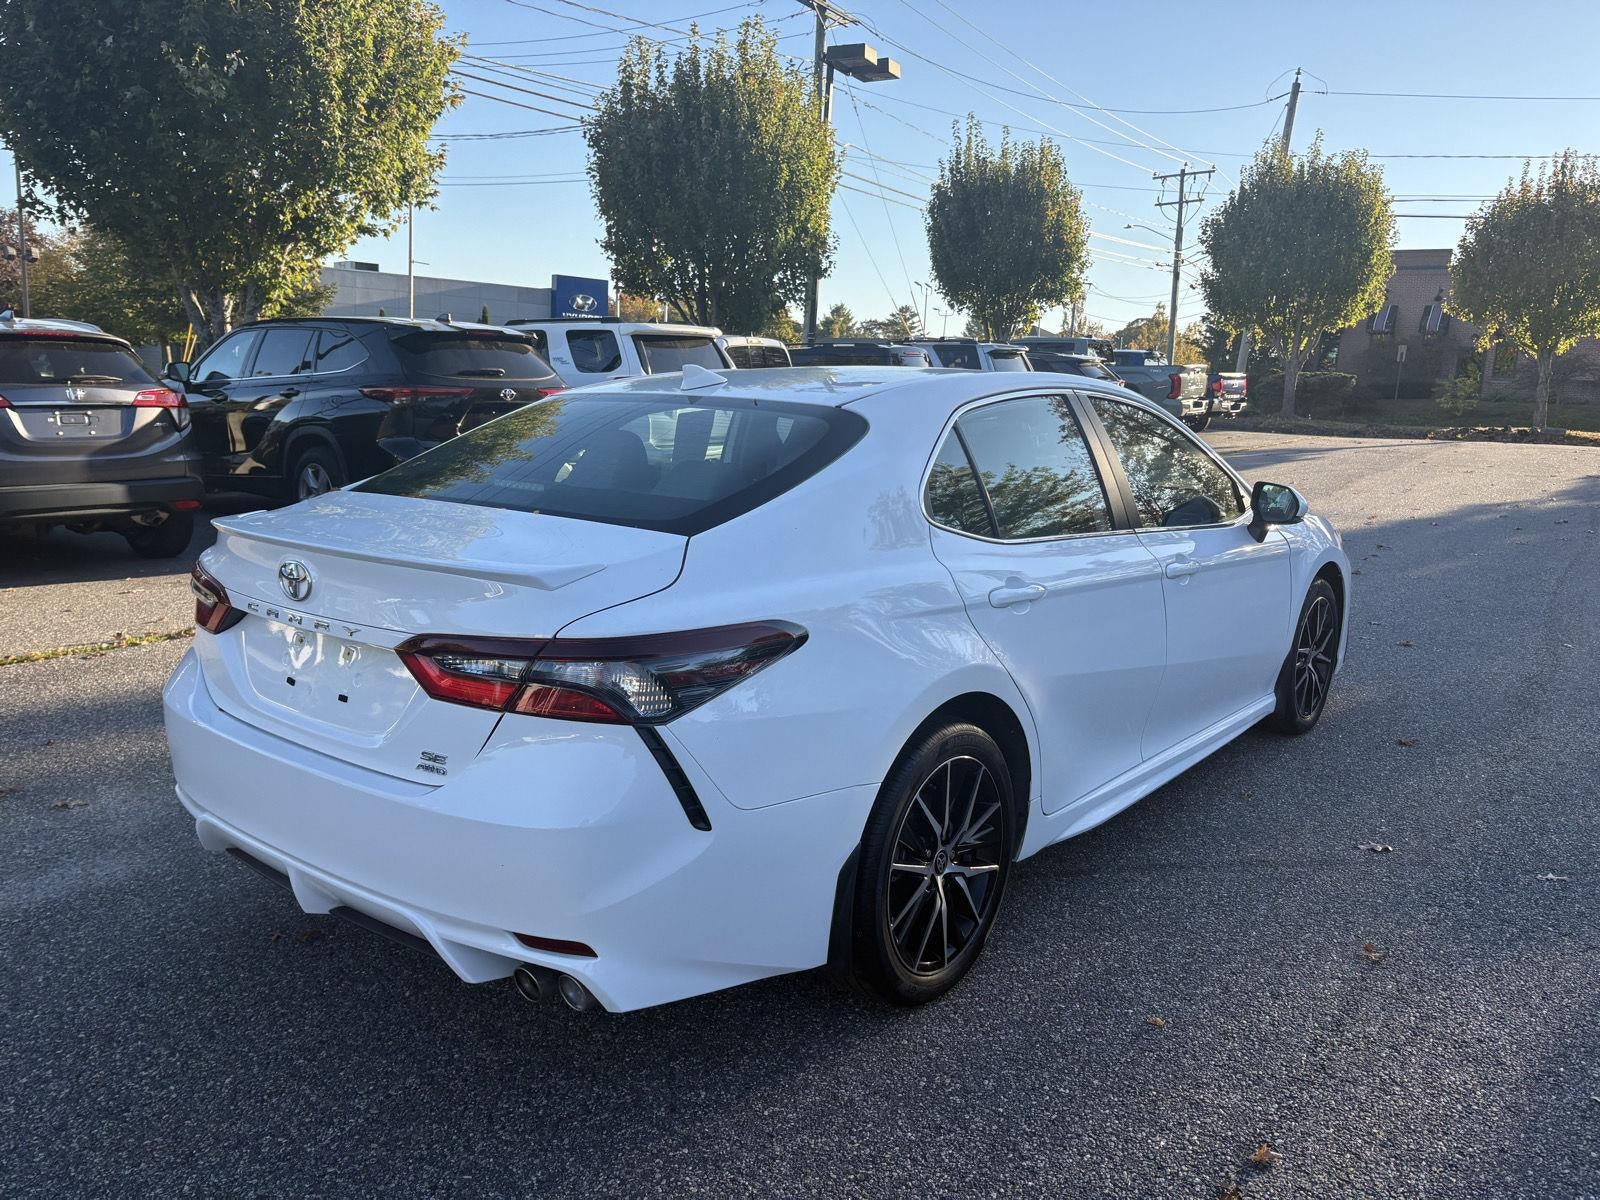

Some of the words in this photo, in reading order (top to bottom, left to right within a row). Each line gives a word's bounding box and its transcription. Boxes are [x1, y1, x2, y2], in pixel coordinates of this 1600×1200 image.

[247, 602, 362, 637] CAMRY
[420, 751, 448, 765] SE
[416, 763, 448, 776] AWD
